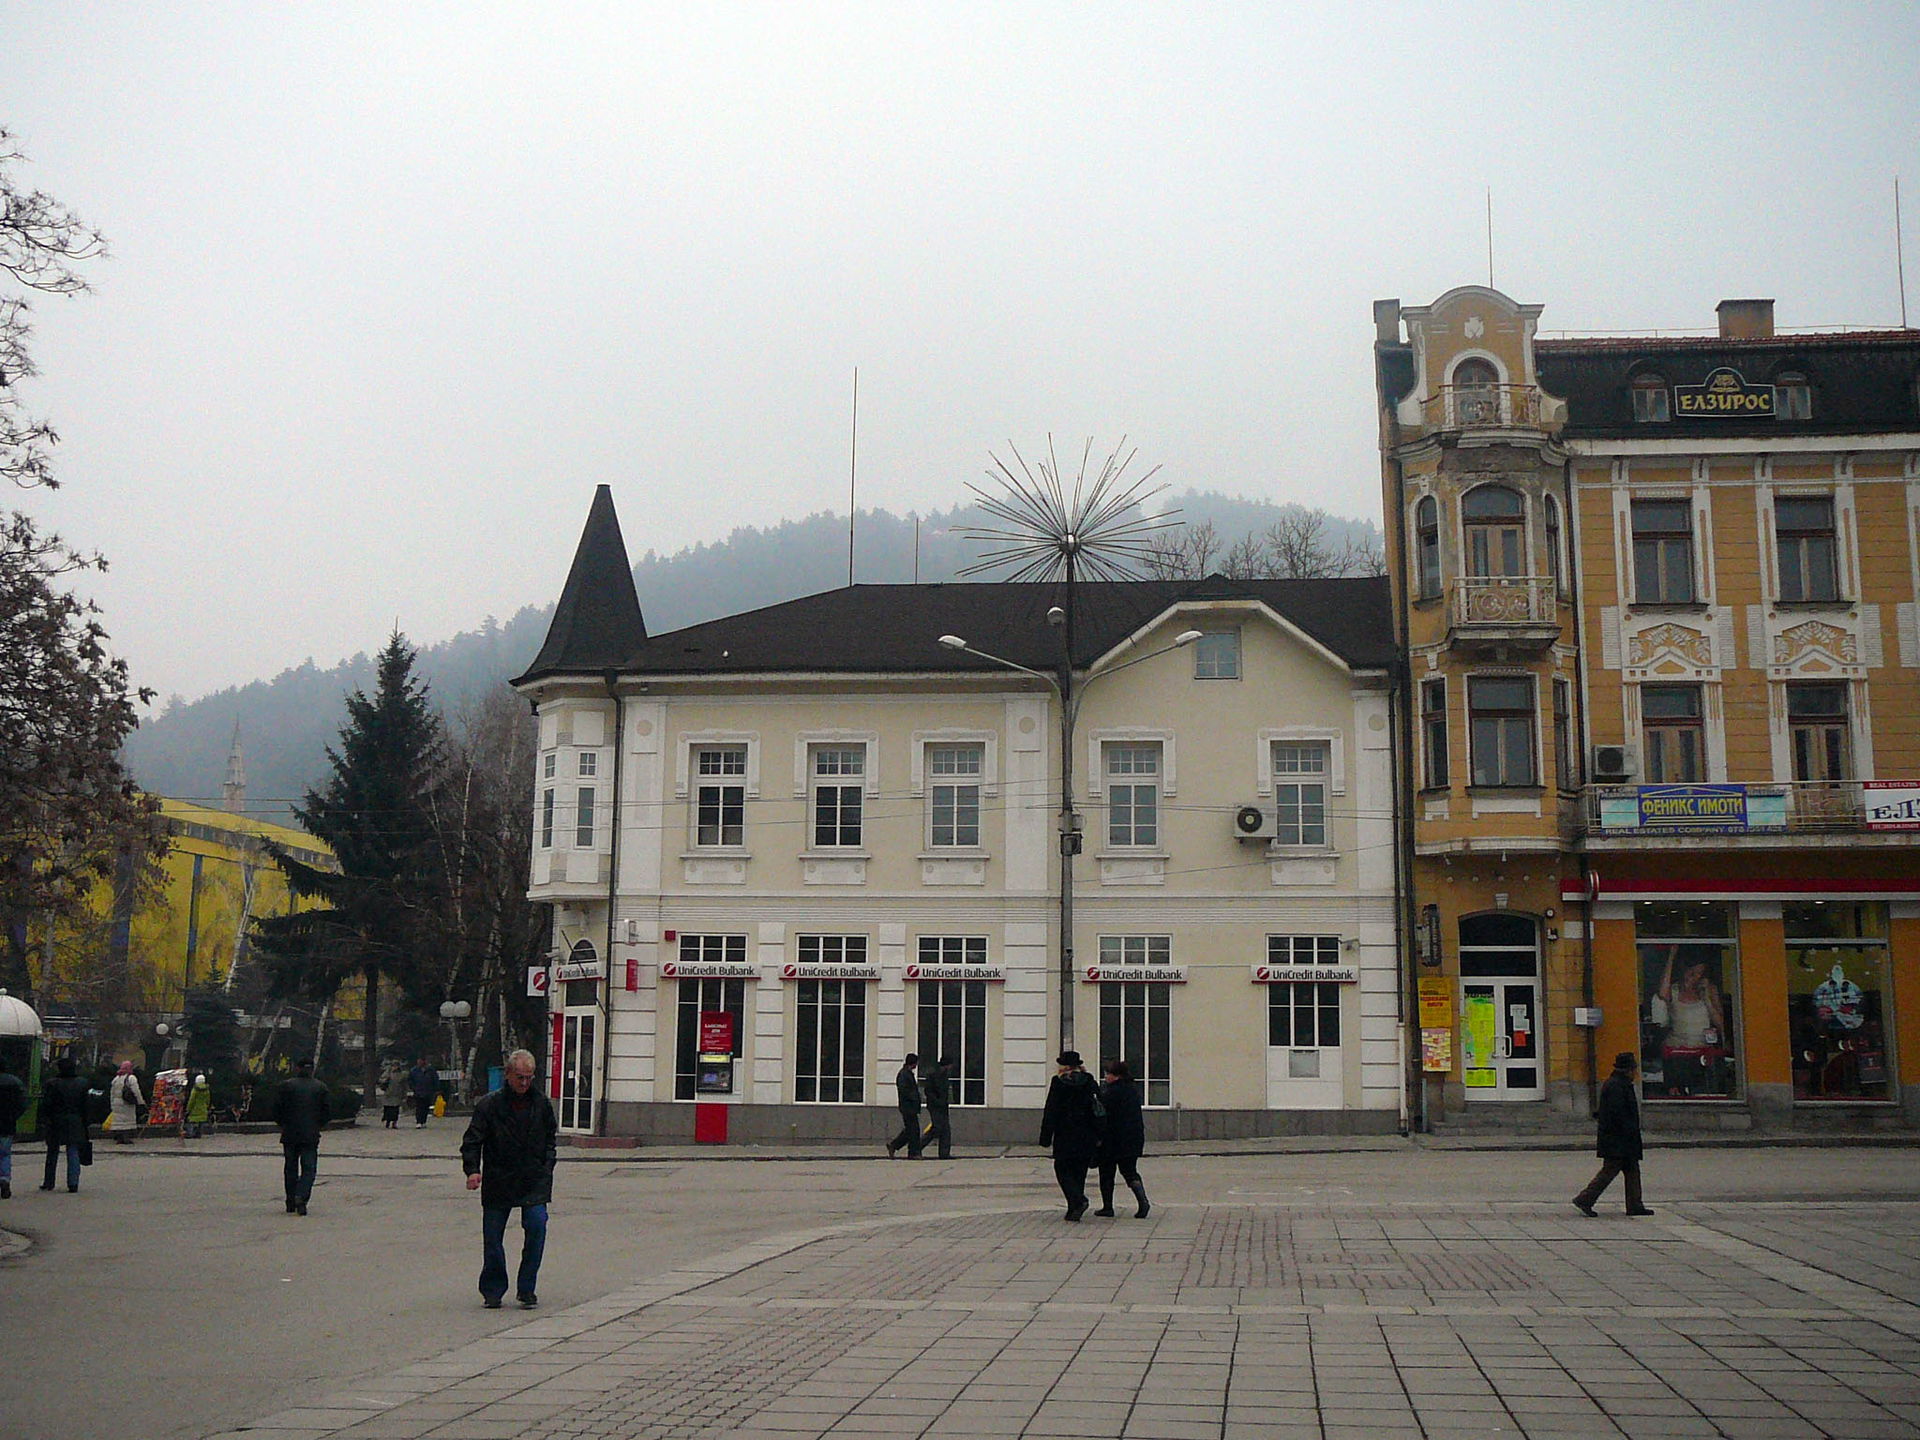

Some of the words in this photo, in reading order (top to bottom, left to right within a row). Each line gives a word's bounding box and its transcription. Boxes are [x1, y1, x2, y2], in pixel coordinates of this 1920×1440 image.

[1680, 393, 1771, 410] ЕЛЗИРОС
[1641, 798, 1696, 816] ФЕНИКС
[1698, 797, 1744, 815] ИМОТИ
[1605, 827, 1631, 835] REAL
[678, 964, 718, 976] UniCredit
[718, 965, 755, 976] Bulbank
[798, 966, 839, 977] UniCredit
[840, 966, 877, 978] Bulbank
[922, 966, 963, 978] UniCredit
[964, 967, 1001, 978] Bulbank
[1102, 968, 1143, 980] UniCredit
[1145, 969, 1183, 980] Bulbank
[1272, 968, 1314, 980] UniCredit
[1314, 969, 1354, 980] Bulbank
